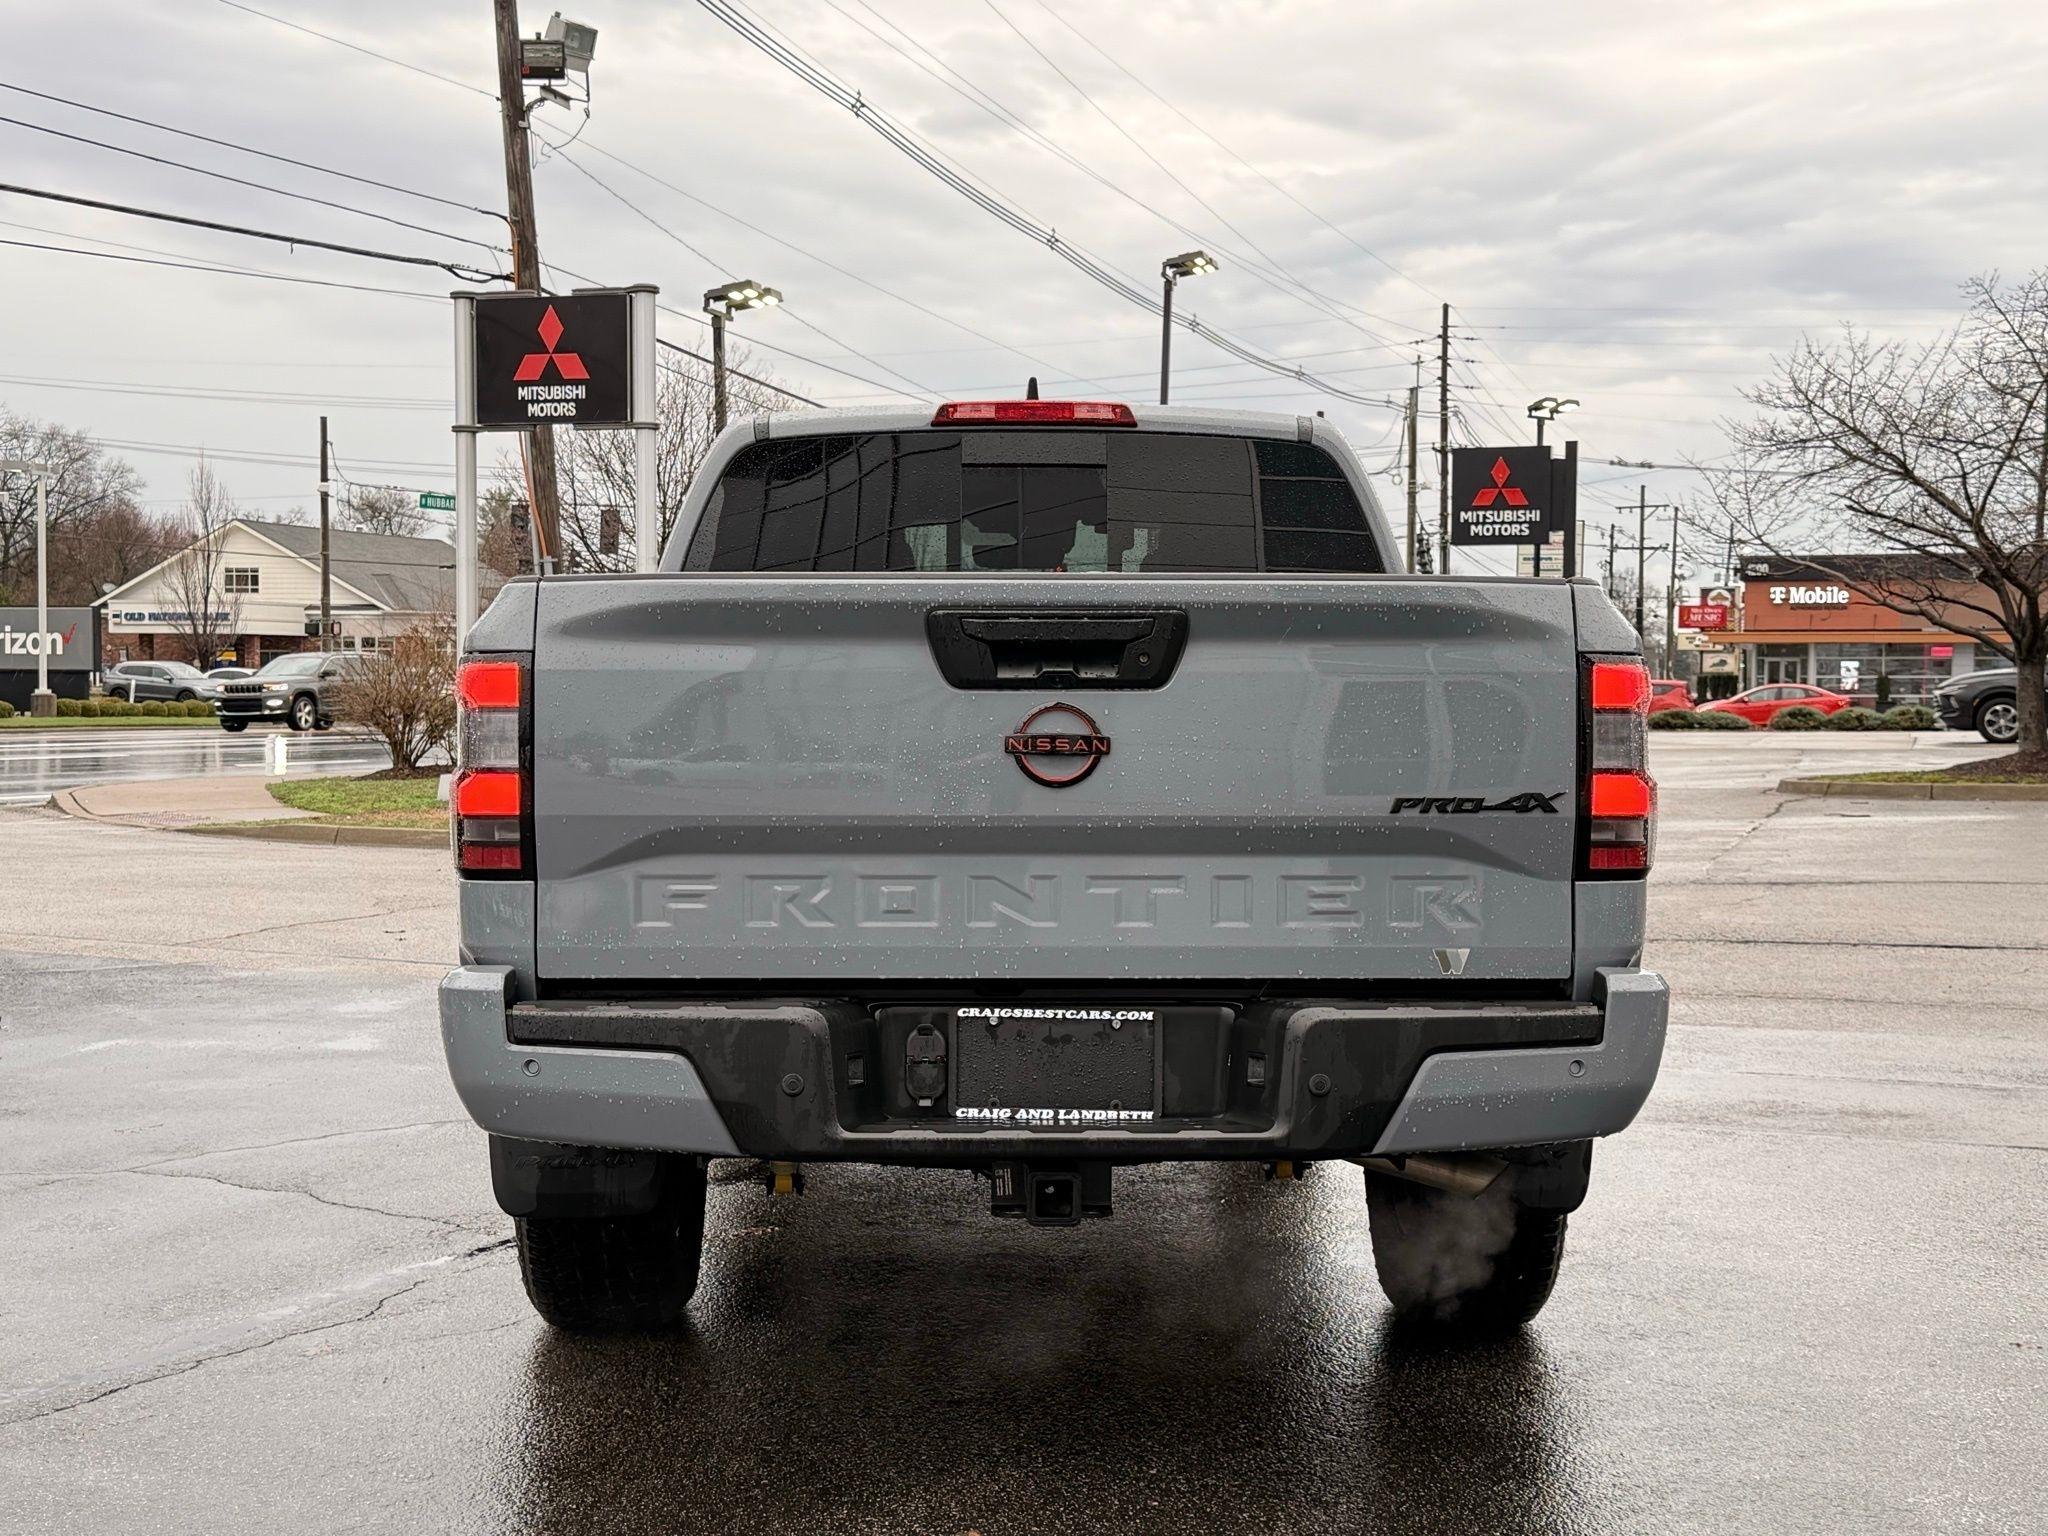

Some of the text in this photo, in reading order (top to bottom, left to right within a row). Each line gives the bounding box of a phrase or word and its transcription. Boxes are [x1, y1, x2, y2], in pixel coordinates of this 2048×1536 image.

[518, 385, 586, 401] MITSUBISHI
[527, 402, 577, 417] MOTORS
[427, 497, 455, 509] HUBBAR
[1460, 509, 1541, 523] MITSUBISHI
[1470, 523, 1530, 537] MOTORS
[124, 611, 146, 622] OLD
[1008, 737, 1107, 752] NISSAN
[1389, 792, 1569, 814] PRO-4X
[632, 873, 1484, 930] FRONTIER
[957, 1007, 1154, 1021] CRAIGSBESTCARS.COM
[955, 1108, 1012, 1119] CRAIG
[1014, 1108, 1055, 1119] AND
